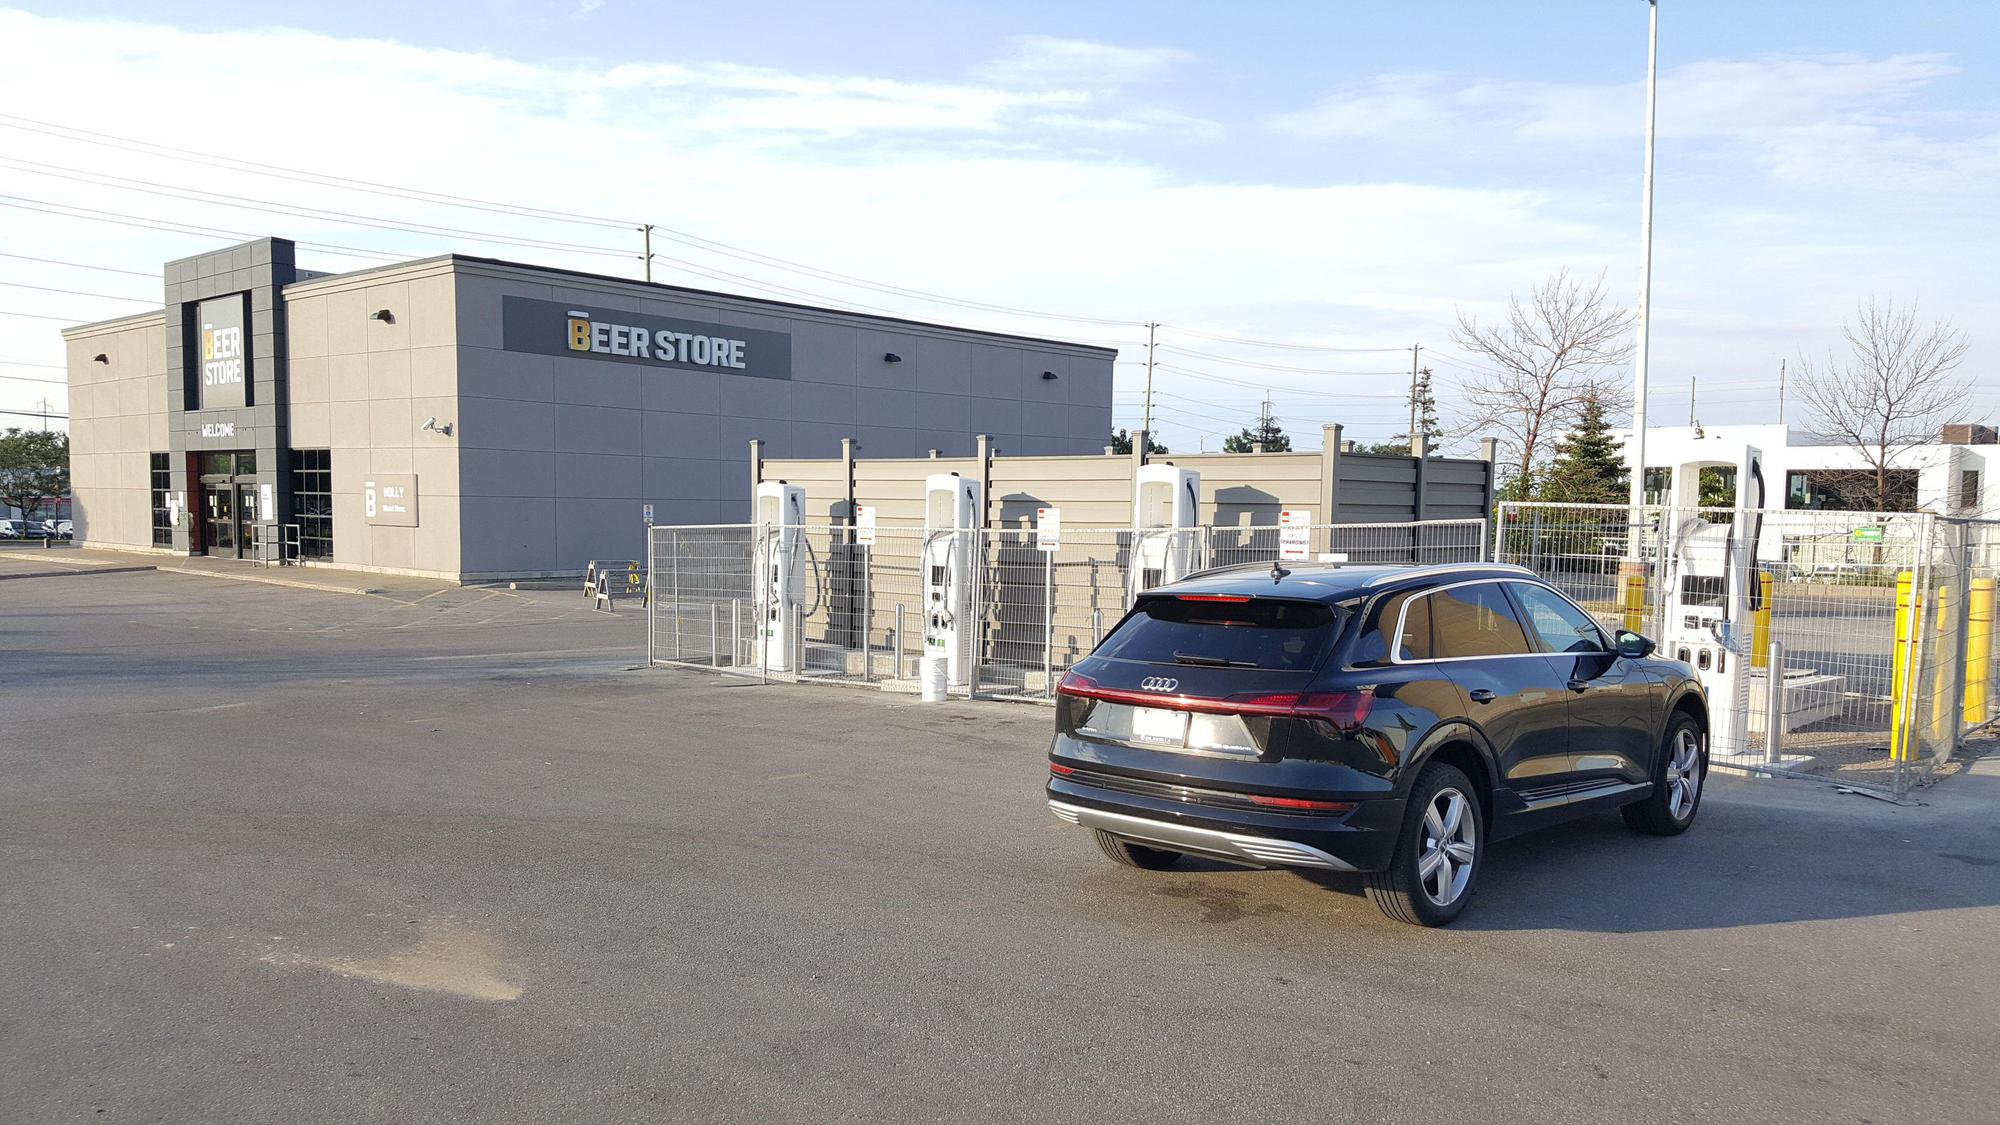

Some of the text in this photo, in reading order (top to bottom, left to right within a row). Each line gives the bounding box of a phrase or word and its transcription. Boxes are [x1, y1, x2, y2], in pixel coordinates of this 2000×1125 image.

[204, 327, 240, 360] BEER
[567, 318, 746, 369] BEER STORE
[205, 359, 241, 386] STORE
[202, 423, 234, 437] WELCOME
